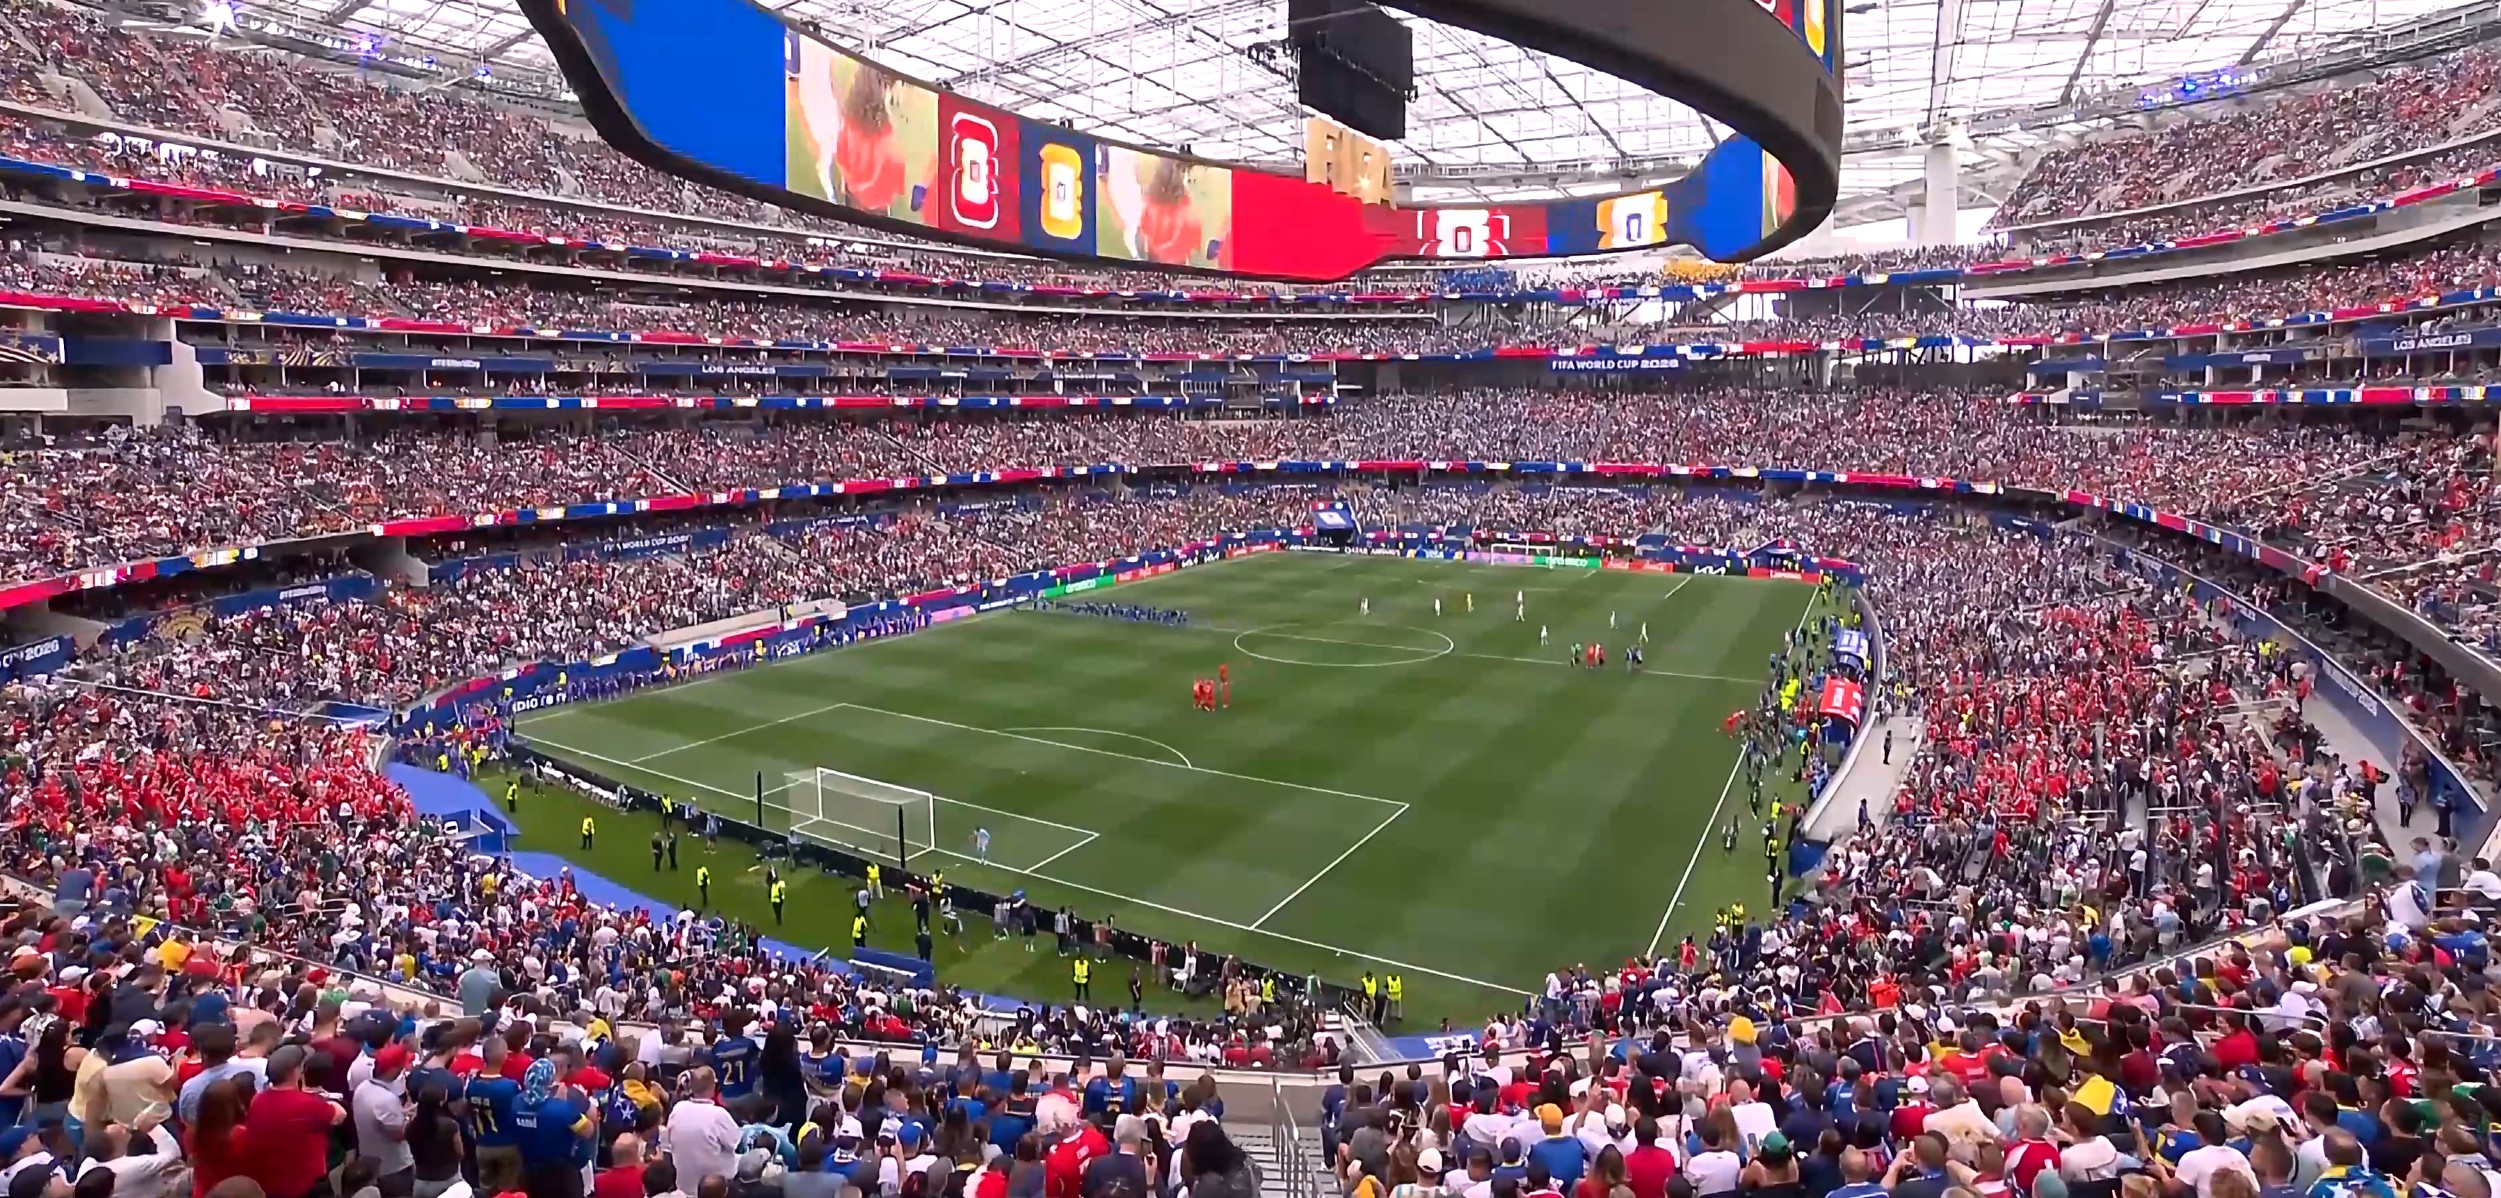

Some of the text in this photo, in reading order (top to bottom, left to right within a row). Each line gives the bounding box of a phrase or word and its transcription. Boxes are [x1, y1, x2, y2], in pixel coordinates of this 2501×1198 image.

[1306, 117, 1397, 211] FIFA
[2393, 337, 2415, 351] LOS
[702, 365, 776, 375] LOS ANGELES
[1552, 359, 1679, 370] FIFA WORLD CUP 2026
[721, 1060, 745, 1086] 21
